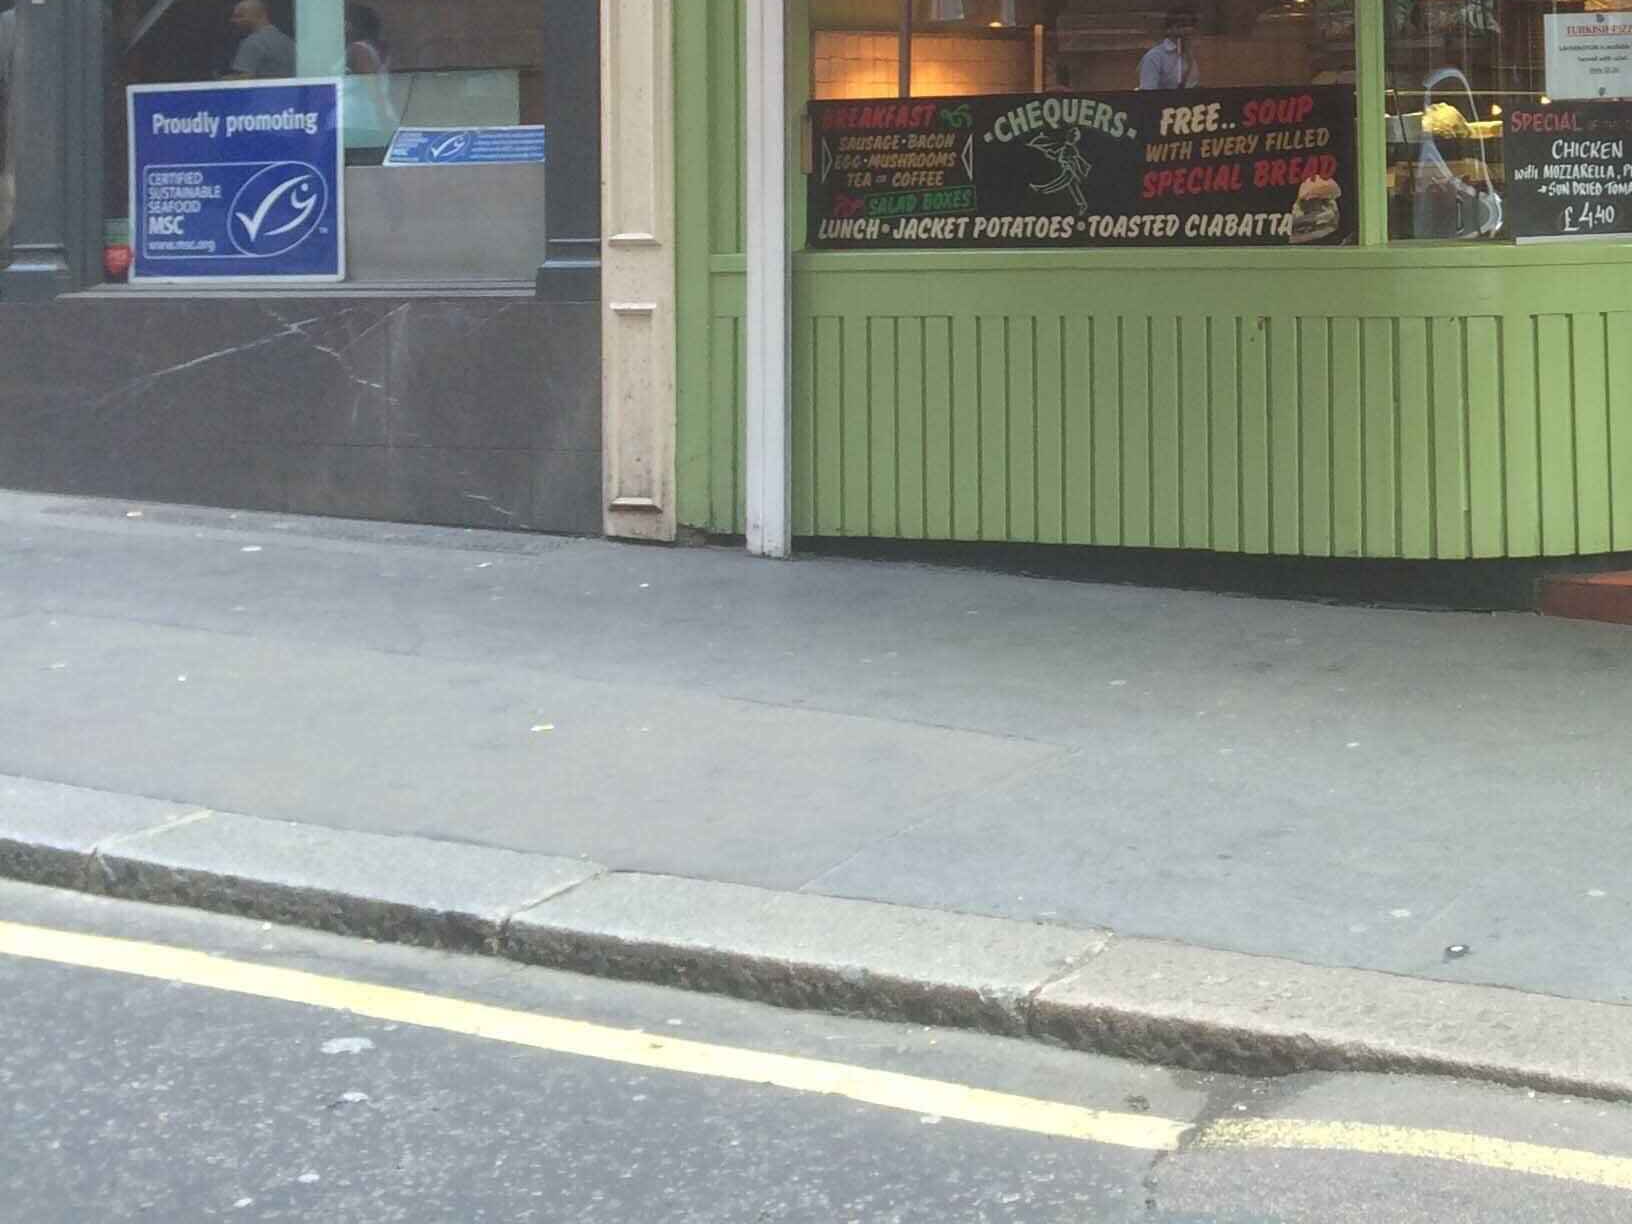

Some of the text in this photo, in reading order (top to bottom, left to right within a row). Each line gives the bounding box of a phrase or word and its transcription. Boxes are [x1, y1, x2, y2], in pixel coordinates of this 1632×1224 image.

[822, 104, 937, 128] BREAKFAST
[994, 98, 1128, 142] CHEQUERS
[1241, 95, 1313, 127] SOUP
[1511, 110, 1583, 132] SPECIAL
[152, 108, 318, 138] Proudly promoting
[839, 133, 956, 151] SAUSAGE BACON
[1145, 128, 1330, 163] WITH EVERY FILLED
[1551, 139, 1623, 159] CHICKEN
[834, 151, 957, 170] EGG MUSHROOMS
[148, 171, 203, 185] CERTIFIED
[847, 172, 872, 187] TEA
[892, 170, 944, 187] COFFEE
[1143, 154, 1337, 198] SPECIAL BREAD
[1514, 164, 1539, 180] with
[148, 185, 222, 199] SUSTAINABLE
[1548, 182, 1569, 196] SUN
[1572, 182, 1602, 195] DRIED
[148, 199, 201, 213] SEAFOOD
[868, 193, 917, 214] SALAD
[923, 188, 972, 210] BOXES
[149, 216, 184, 234] MSC
[818, 213, 1294, 240] LUNCH JACKET POTATOES TOASTED CIABATTA
